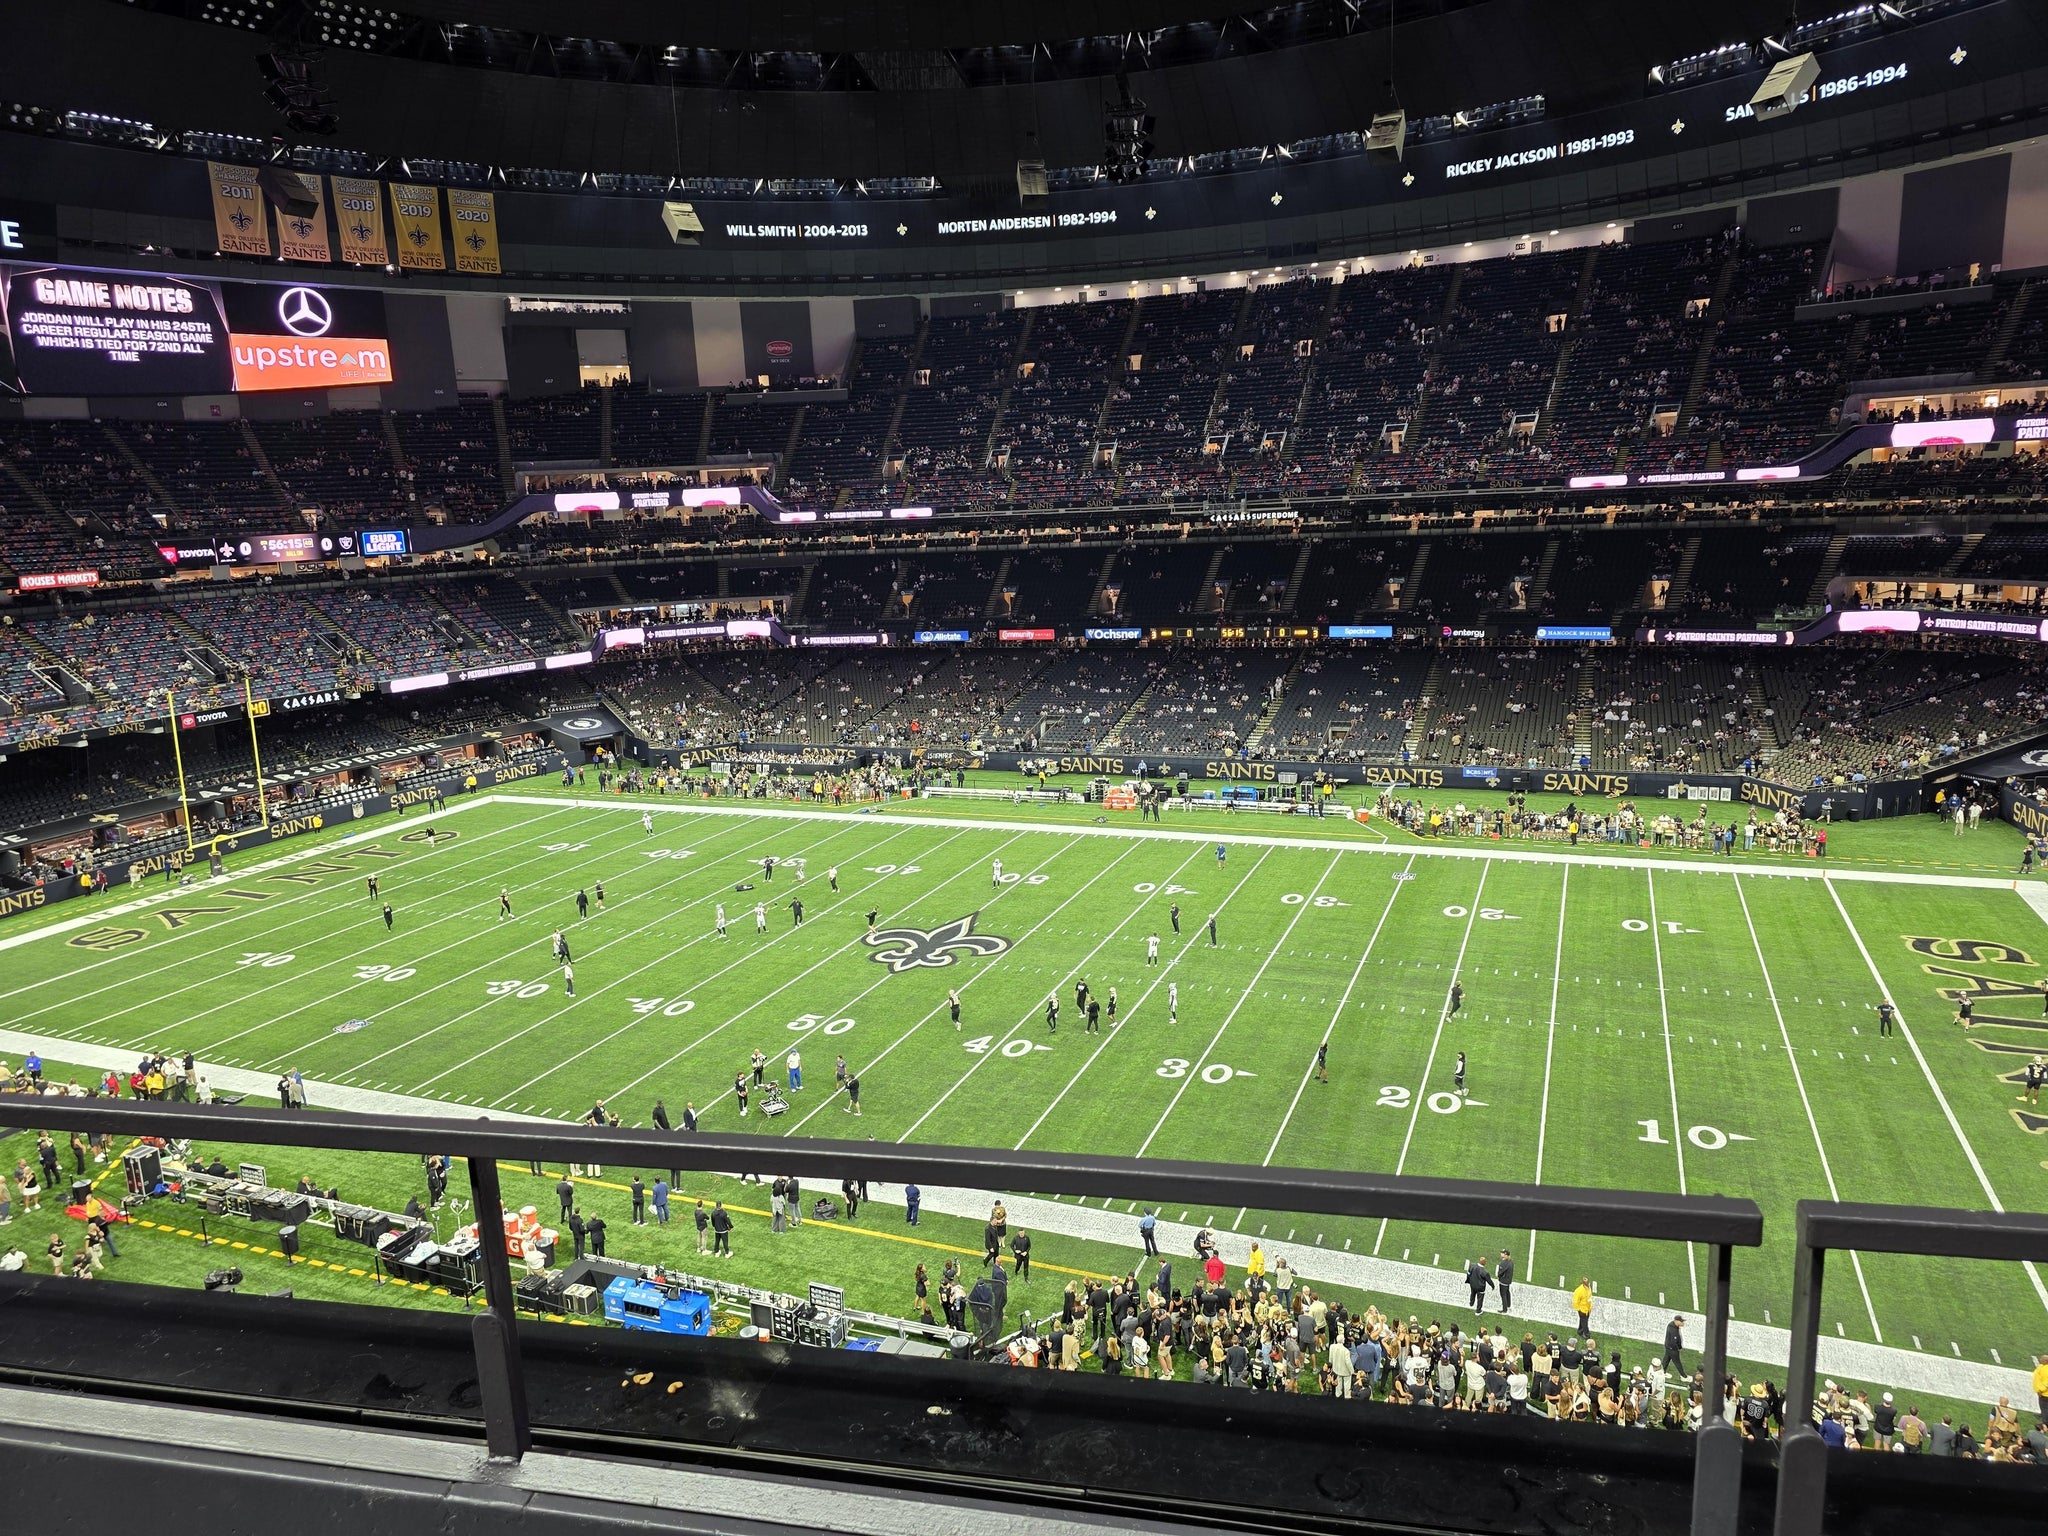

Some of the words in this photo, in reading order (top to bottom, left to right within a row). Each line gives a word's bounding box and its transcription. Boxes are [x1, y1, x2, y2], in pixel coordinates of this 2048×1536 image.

[1820, 63, 1908, 100] 1986-1994
[1446, 158, 1492, 178] RICKEY
[1494, 145, 1556, 170] JACKSON
[1566, 129, 1635, 155] 1981-1993
[222, 185, 252, 200] 2011
[343, 199, 374, 211] 2018
[400, 204, 432, 217] 2019
[456, 209, 489, 222] 2020
[938, 220, 987, 234] MORTEN
[989, 216, 1050, 230] ANDERSEN
[1058, 210, 1117, 226] 1982-1994
[0, 220, 24, 248] E
[726, 225, 756, 236] WILL
[758, 225, 796, 236] SMITH
[804, 225, 868, 236] 2004-2013
[223, 240, 266, 253] SAINTS
[284, 247, 326, 259] SAINTS
[345, 251, 386, 262] SAINTS
[402, 256, 442, 268] SAINTS
[458, 260, 498, 272] SAINTS
[36, 278, 111, 308] GAME
[114, 284, 193, 313] NOTES
[21, 312, 72, 325] JORDAN
[74, 316, 104, 326] WILL
[105, 317, 134, 328] PLAY
[137, 319, 149, 328] IN
[150, 320, 170, 330] HIS
[172, 321, 210, 332] 245TH
[22, 324, 72, 336] CAREER
[74, 326, 130, 339] REGULAR
[132, 330, 178, 342] SEASON
[180, 332, 214, 343] GAME
[37, 336, 79, 348] WHICH
[81, 338, 94, 348] IS
[95, 340, 122, 350] TIED
[124, 341, 148, 350] FOR
[150, 342, 180, 352] 72ND
[183, 344, 204, 354] ALL
[109, 351, 140, 362] TIME
[2016, 418, 2046, 428] PATRON
[2018, 426, 2048, 438] PART
[1693, 472, 1726, 480] PARTNERS
[1416, 484, 1448, 492] SAINTS
[1490, 480, 1523, 488] SAINTS
[2007, 484, 2046, 494] SAINTS
[1279, 490, 1308, 498] SAINTS
[1346, 487, 1376, 496] SAINTS
[1833, 489, 1870, 498] SAINTS
[1919, 487, 1958, 496] SAINTS
[969, 504, 996, 512] SAINTS
[1028, 502, 1054, 510] SAINTS
[1087, 500, 1113, 508] SAINTS
[1210, 514, 1252, 522] CAESARS
[1252, 511, 1298, 520] SUPERDOME
[370, 533, 397, 544] BUD
[178, 548, 214, 558] TOYOTA
[240, 542, 252, 556] 0
[269, 538, 302, 550] 56:15
[321, 538, 332, 550] 0
[367, 541, 404, 552] LIGHT
[22, 576, 56, 588] ROUSES
[58, 573, 98, 585] MARKETS
[108, 569, 142, 579] SAINTS
[1344, 628, 1374, 636] Spectrum
[1397, 628, 1426, 636] SAINTS
[1935, 618, 1966, 629] PATRON
[1966, 620, 1994, 631] SAINTS
[1994, 622, 2036, 634] PARTNERS
[934, 632, 961, 640] Allstate
[1002, 630, 1034, 639] Community
[1094, 630, 1139, 639] Ochsner
[1222, 629, 1244, 638] 56:15
[1453, 630, 1484, 638] entergy
[1676, 632, 1706, 642] PATRON
[1707, 632, 1735, 642] SAINTS
[1736, 632, 1777, 642] PARTNERS
[346, 684, 375, 694] SAINTS
[283, 692, 340, 708] CAESARS
[196, 712, 228, 722] TOYOTA
[108, 722, 146, 736] SAINTS
[18, 737, 59, 752] SAINTS
[309, 742, 442, 772] SUPERDOME
[496, 762, 537, 782] SAINTS
[1061, 758, 1124, 774] SAINTS
[1206, 762, 1275, 780] SAINTS
[1366, 768, 1443, 786] SAINTS
[1544, 773, 1628, 794] SAINTS
[390, 786, 437, 809] SAINTS
[2014, 802, 2048, 836] SAINT
[66, 829, 460, 951] SAINTS
[0, 888, 46, 916] INTS
[237, 953, 296, 968] 10
[353, 964, 416, 983] 20
[487, 980, 550, 998] 30
[628, 998, 694, 1016] 40
[787, 1014, 856, 1036] 50
[963, 1035, 1033, 1058] 40
[1156, 1059, 1233, 1084] 30
[2034, 1069, 2040, 1078] 5
[1376, 1086, 1463, 1114] 20
[1638, 1119, 1728, 1150] 10
[509, 1238, 520, 1252] G
[1252, 1370, 1262, 1380] 13
[1748, 1404, 1764, 1419] 98
